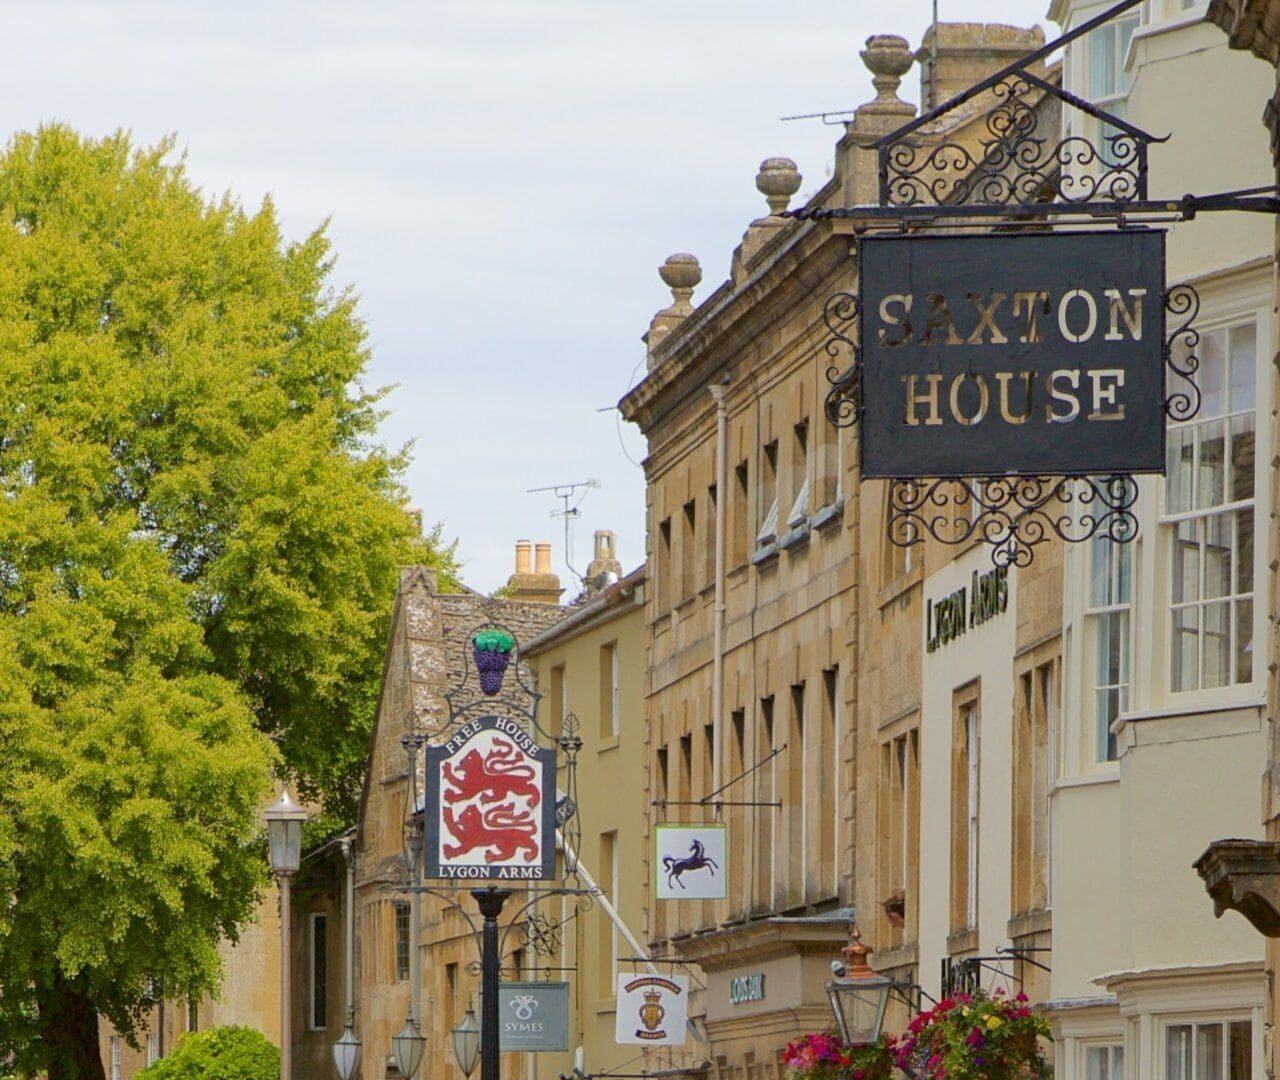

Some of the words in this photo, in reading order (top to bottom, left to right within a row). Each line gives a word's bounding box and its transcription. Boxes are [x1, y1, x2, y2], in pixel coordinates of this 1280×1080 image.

[877, 288, 1147, 349] SAXTON
[900, 368, 1126, 427] HOUSE
[445, 718, 482, 754] FREE
[495, 717, 539, 757] HOUSE
[439, 866, 490, 878] LYGON
[498, 866, 543, 878] ARMS
[504, 1022, 544, 1032] SYMES
